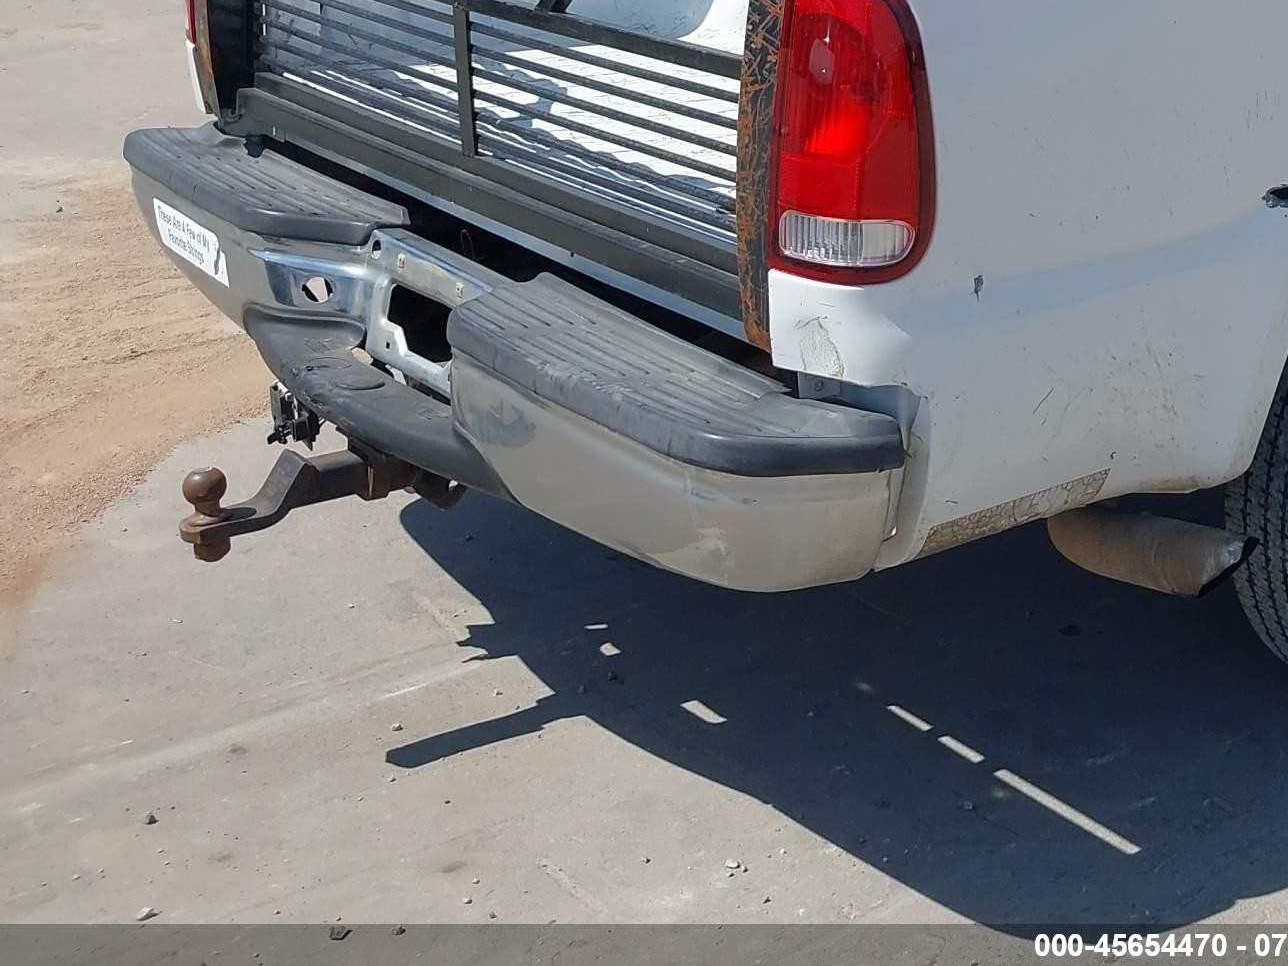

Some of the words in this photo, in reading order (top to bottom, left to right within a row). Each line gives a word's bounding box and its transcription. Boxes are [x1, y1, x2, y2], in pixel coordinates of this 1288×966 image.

[157, 205, 172, 226] These
[173, 215, 182, 232] Are
[186, 223, 196, 241] Few
[202, 233, 210, 253] My
[167, 228, 188, 252] Favorite
